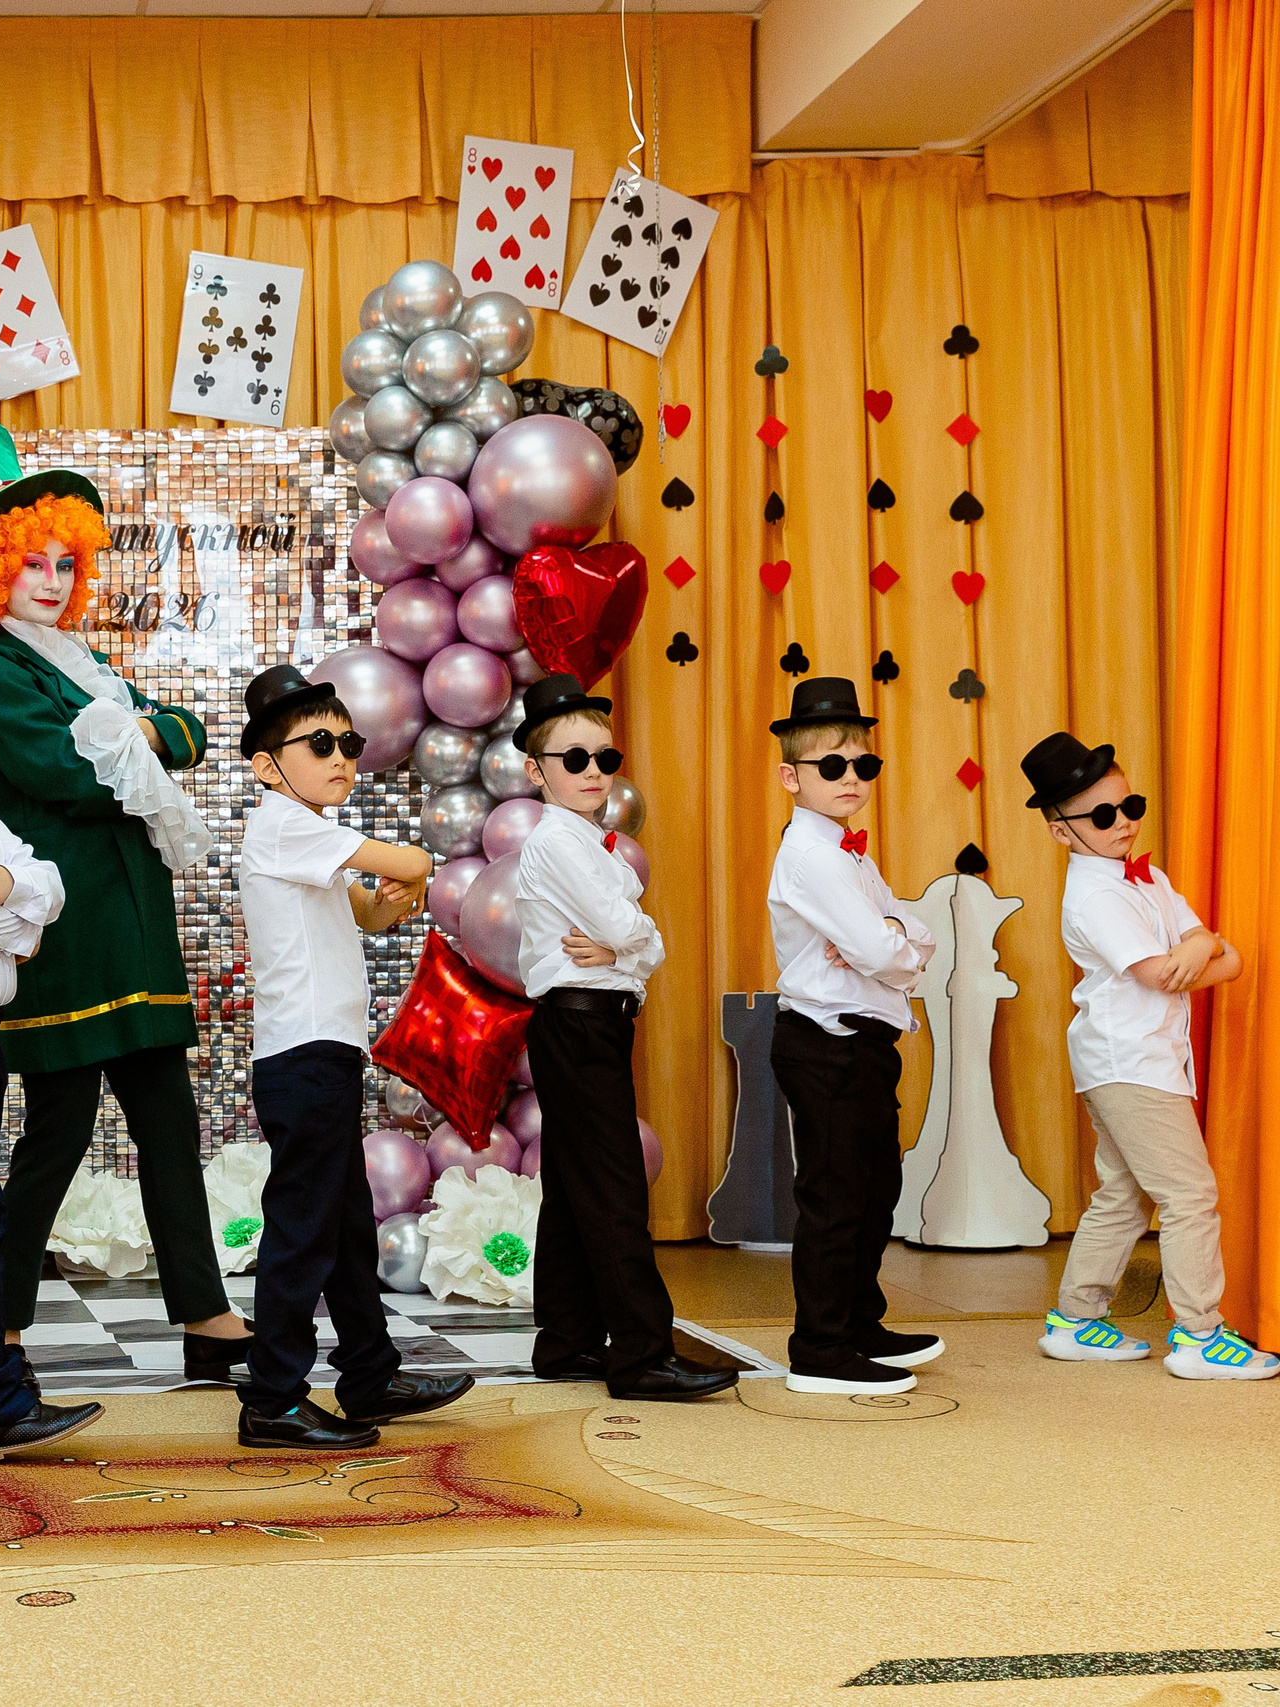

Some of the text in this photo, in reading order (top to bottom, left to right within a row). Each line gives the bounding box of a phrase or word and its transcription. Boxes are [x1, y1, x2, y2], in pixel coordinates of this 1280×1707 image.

[468, 147, 478, 163] 8
[193, 264, 204, 280] 9
[548, 282, 557, 297] 8
[59, 350, 71, 366] 8
[99, 591, 220, 633] 2026
